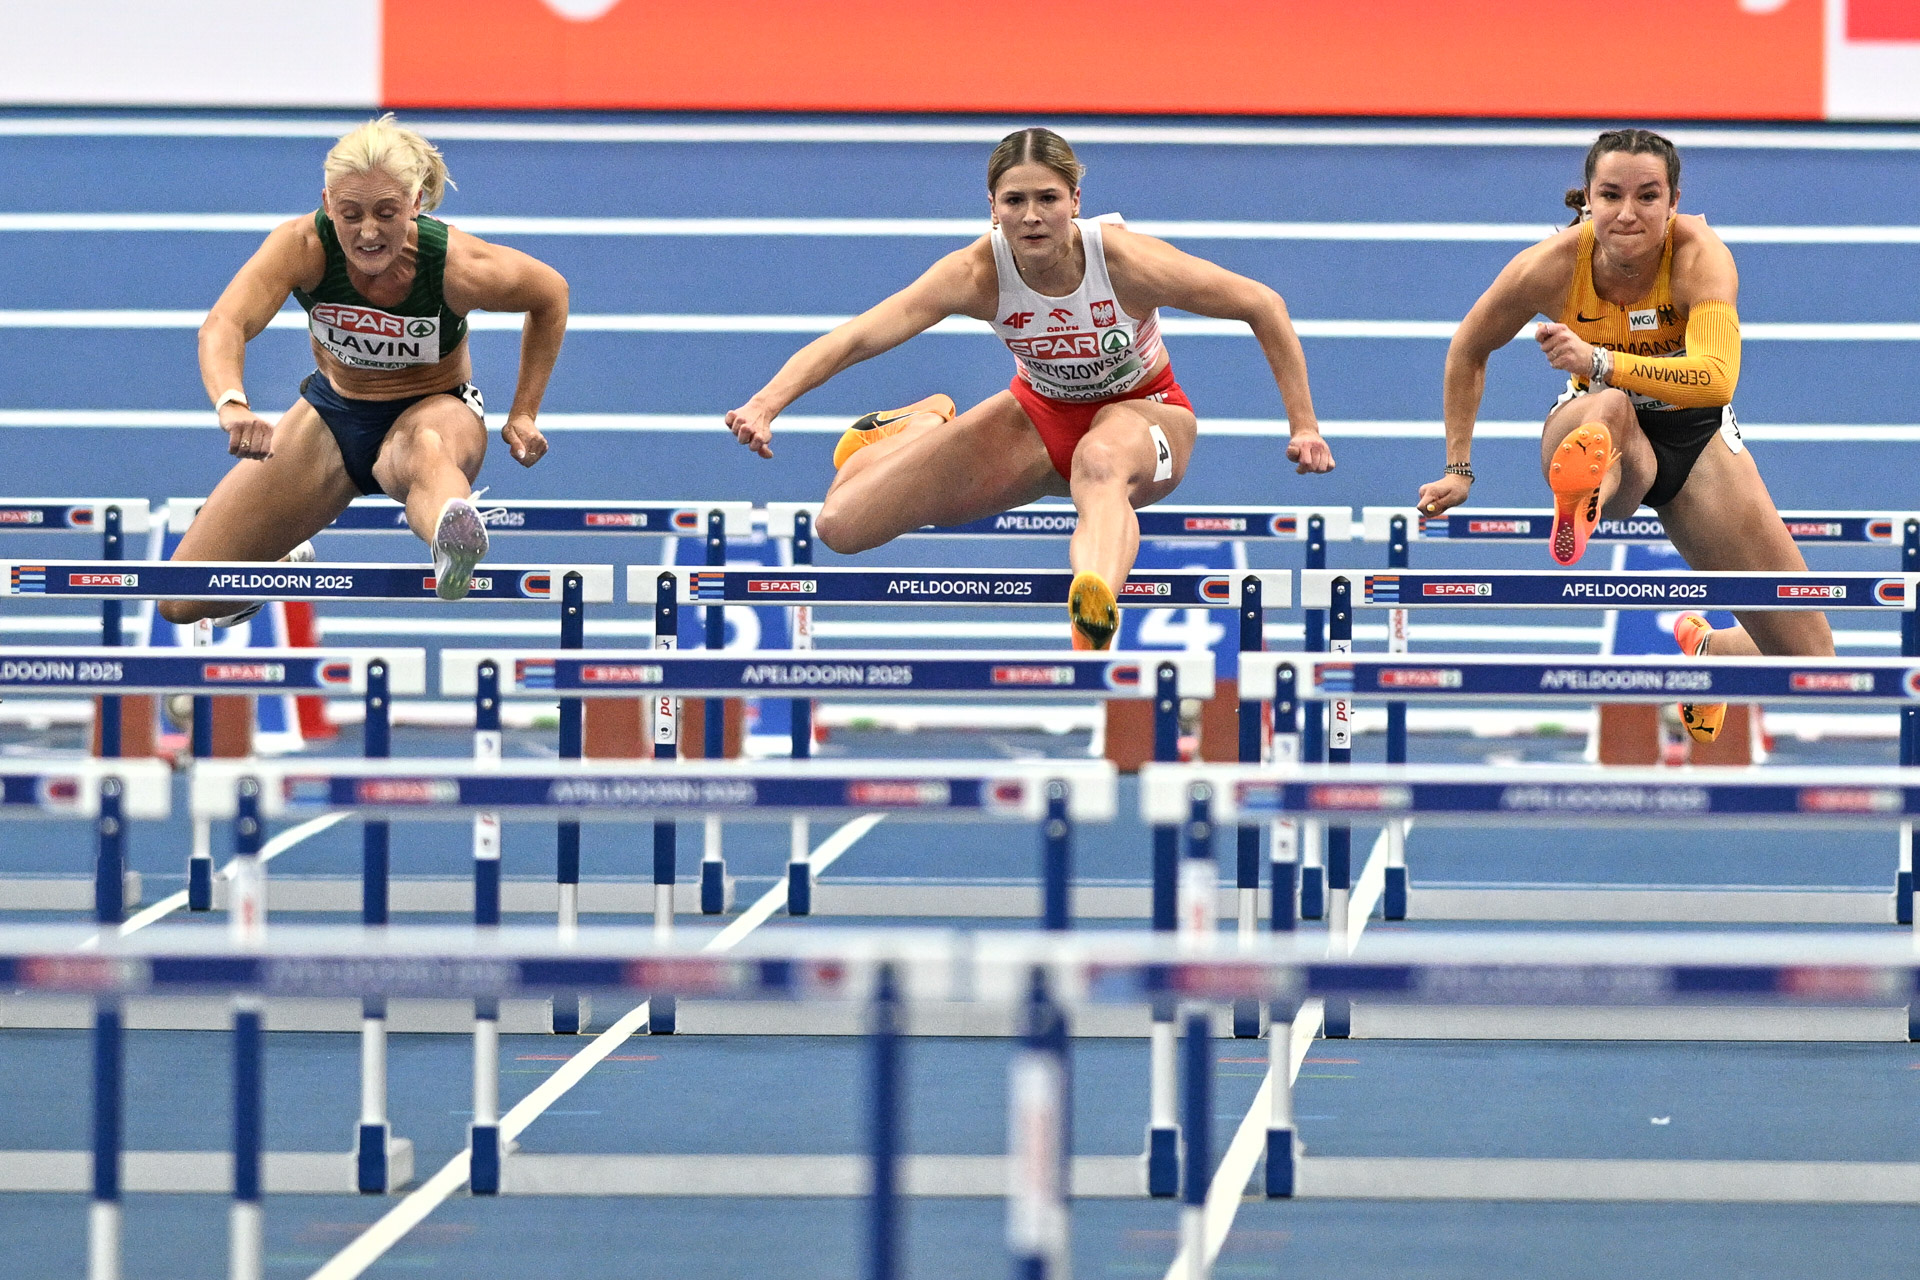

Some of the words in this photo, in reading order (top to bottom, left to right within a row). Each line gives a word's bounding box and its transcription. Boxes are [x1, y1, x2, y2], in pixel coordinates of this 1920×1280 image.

[315, 308, 402, 335] SPAR
[1002, 312, 1035, 329] 4F
[1630, 314, 1657, 326] WGV
[328, 328, 420, 357] LAVIN
[1009, 336, 1097, 358] SPAR
[1629, 363, 1711, 386] GERMANY
[1159, 440, 1169, 464] 4
[81, 576, 122, 585] SPAR
[208, 574, 312, 589] APELDOORN
[314, 575, 353, 590] 2025
[760, 582, 800, 590] SPAR
[887, 580, 990, 595] APELDOORN
[993, 582, 1032, 595] 2025
[1435, 585, 1476, 594] SPAR
[1562, 583, 1666, 598] APELDOORN
[1668, 585, 1707, 598] 2025
[1789, 587, 1830, 596] SPAR
[77, 662, 124, 682] 2025
[741, 663, 864, 684] APELDOORN
[865, 664, 913, 685] 2025
